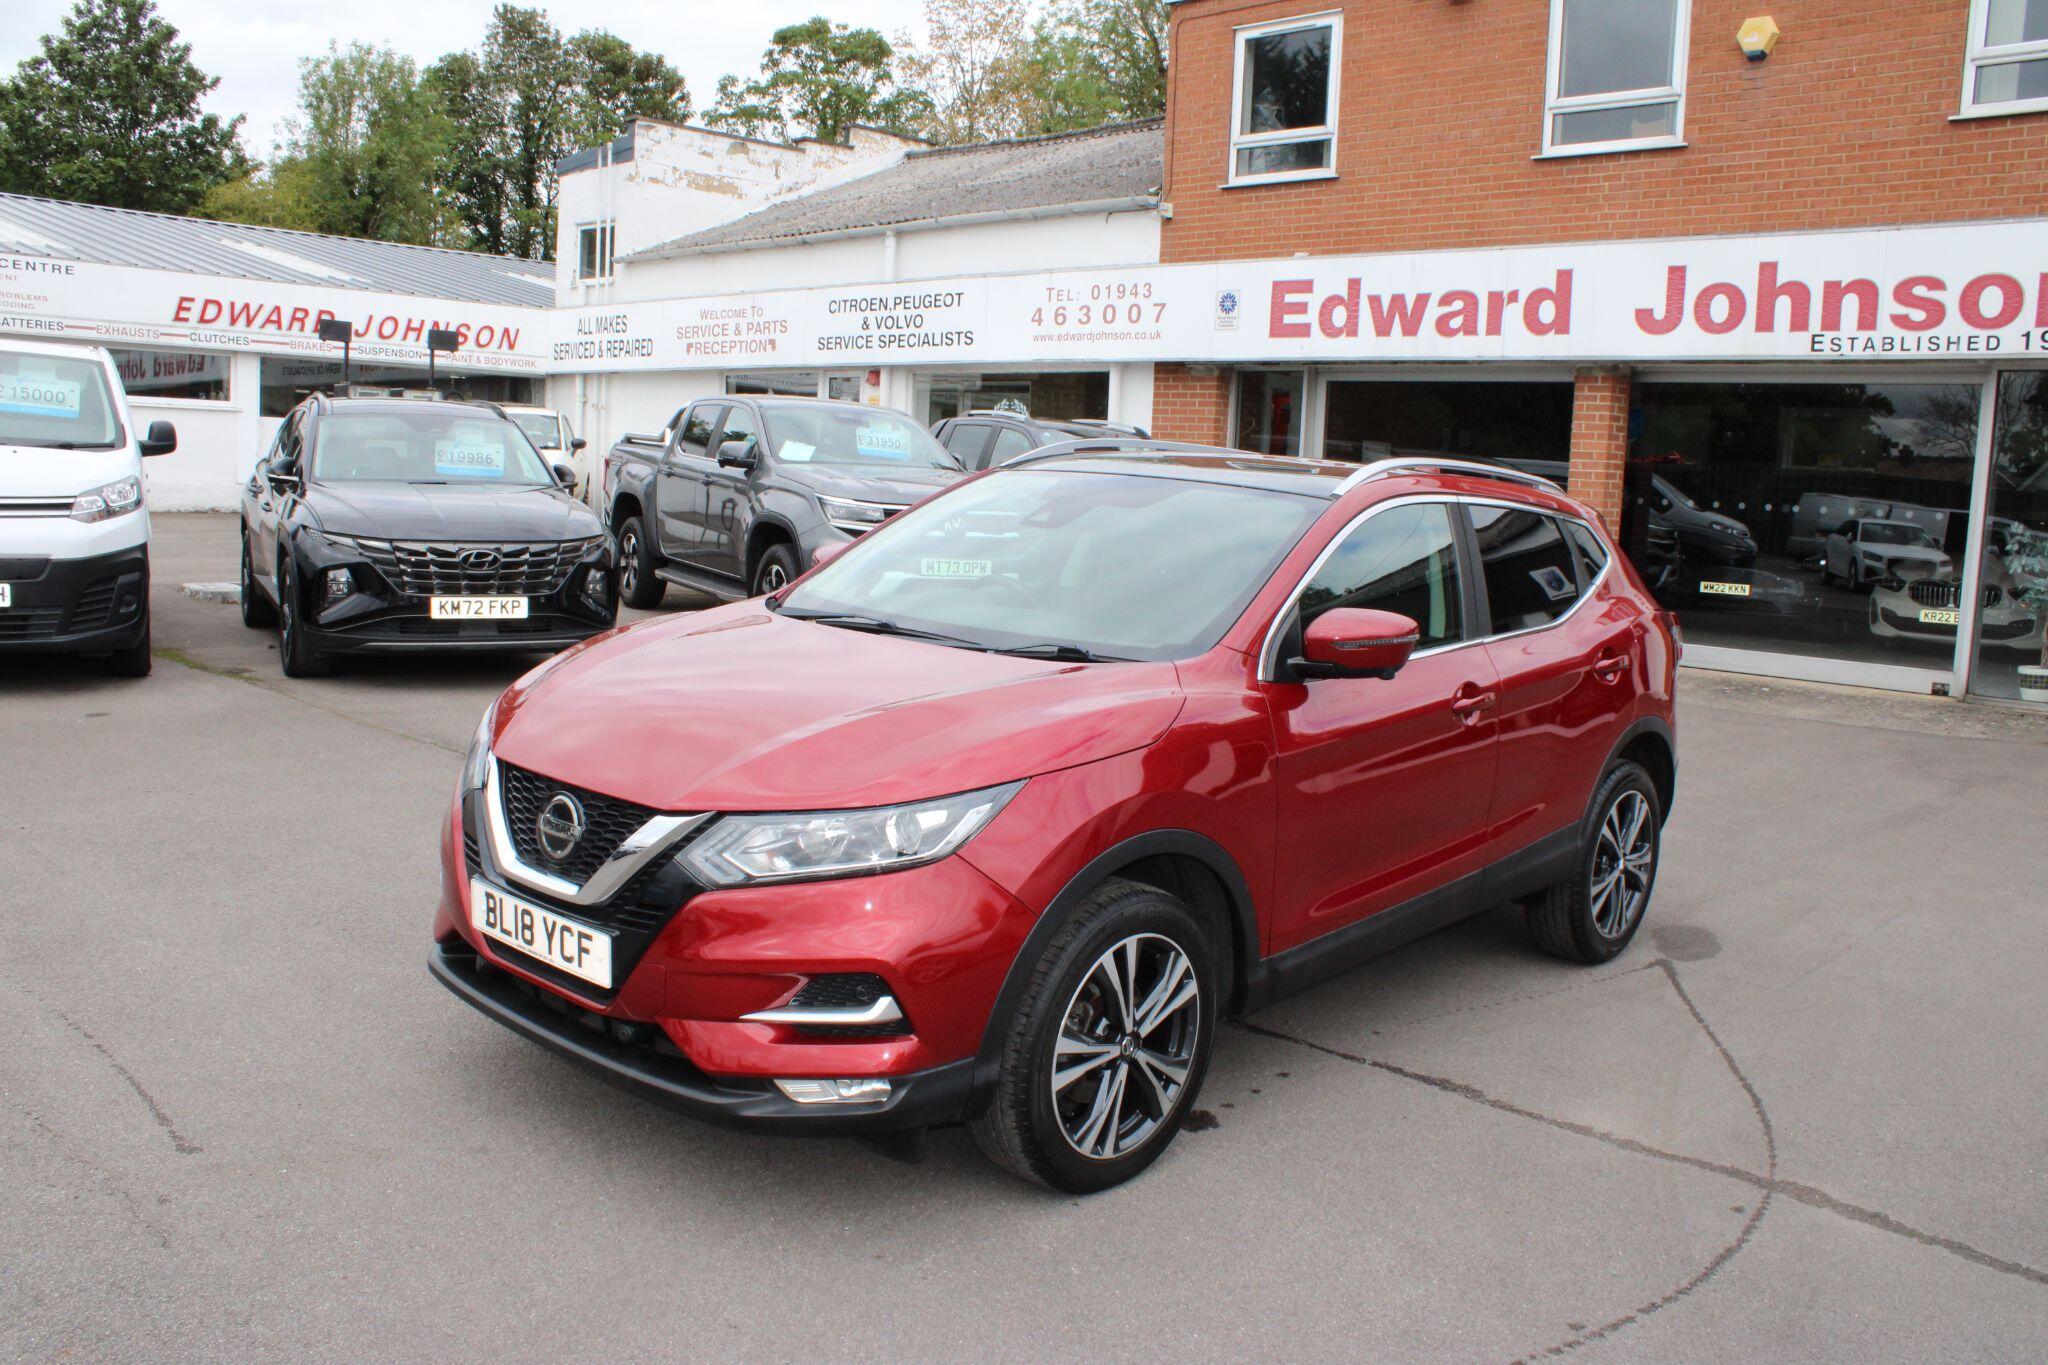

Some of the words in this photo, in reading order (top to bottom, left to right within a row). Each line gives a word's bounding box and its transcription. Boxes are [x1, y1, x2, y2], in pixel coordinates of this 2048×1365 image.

[0, 258, 76, 276] CENTRE
[1091, 282, 1152, 301] 01943
[0, 300, 36, 310] ODING
[1268, 269, 1574, 339] Edward
[96, 324, 160, 339] EXHAUSTS
[577, 318, 593, 335] ALL
[595, 315, 628, 334] MAKES
[676, 323, 729, 340] SERVICE
[734, 322, 743, 337] &
[746, 319, 788, 336] PARTS
[861, 317, 870, 331] &
[875, 314, 924, 331] VOLVO
[189, 332, 250, 346] CLUTCHES
[290, 340, 334, 352] BRAKES
[818, 334, 874, 350] SERVICE
[878, 330, 974, 349] SPECIALISTS
[1033, 330, 1162, 344] www.edwardjohnson.co.uk
[1810, 333, 2001, 353] ESTABLISHED
[358, 345, 422, 360] SUSPENSION
[553, 341, 595, 361] SERVICED
[597, 340, 605, 358] &
[606, 338, 654, 358] REPAIRED
[694, 338, 768, 356] RECEPTION
[445, 352, 473, 364] PAINT
[475, 355, 482, 365] &
[484, 356, 537, 369] BODYWORK
[440, 600, 484, 615] KM72
[489, 600, 521, 615] FKP
[1923, 611, 1951, 622] KR22
[541, 815, 576, 837] NISSAN
[484, 890, 535, 947] BL18
[543, 915, 593, 969] YCF
